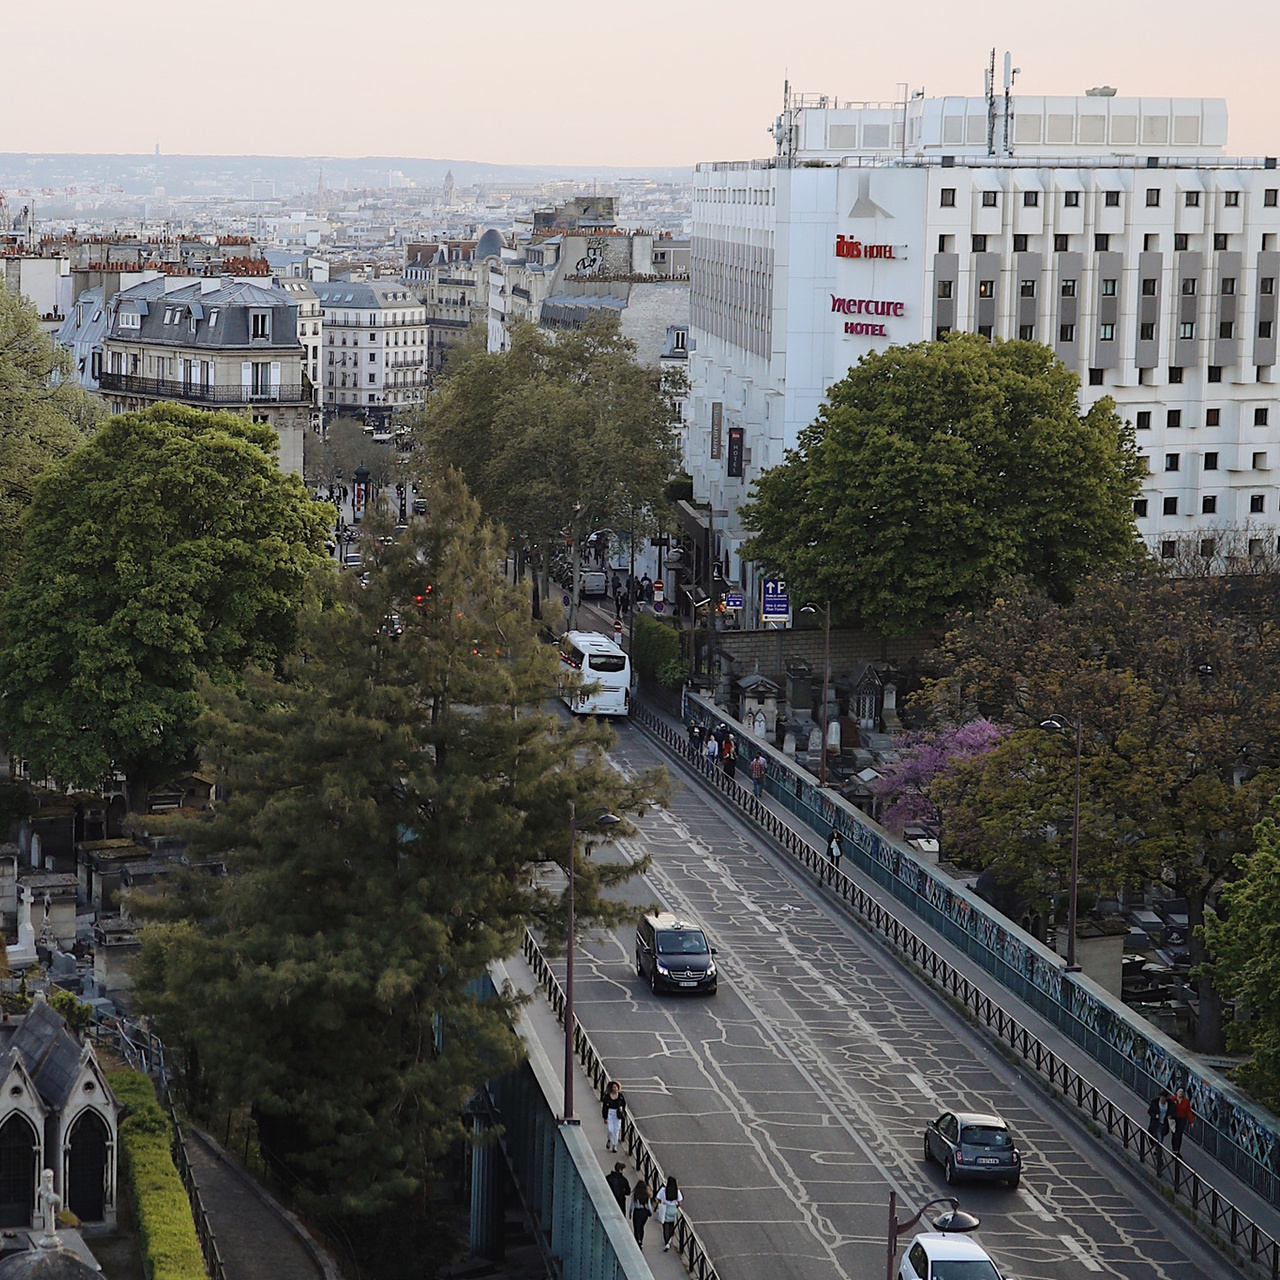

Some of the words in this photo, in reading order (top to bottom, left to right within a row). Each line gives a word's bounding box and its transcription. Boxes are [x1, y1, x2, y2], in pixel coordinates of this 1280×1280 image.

[836, 234, 862, 258] ibis
[864, 244, 896, 259] HOTEL
[844, 321, 887, 337] HOTEL
[777, 581, 786, 594] P
